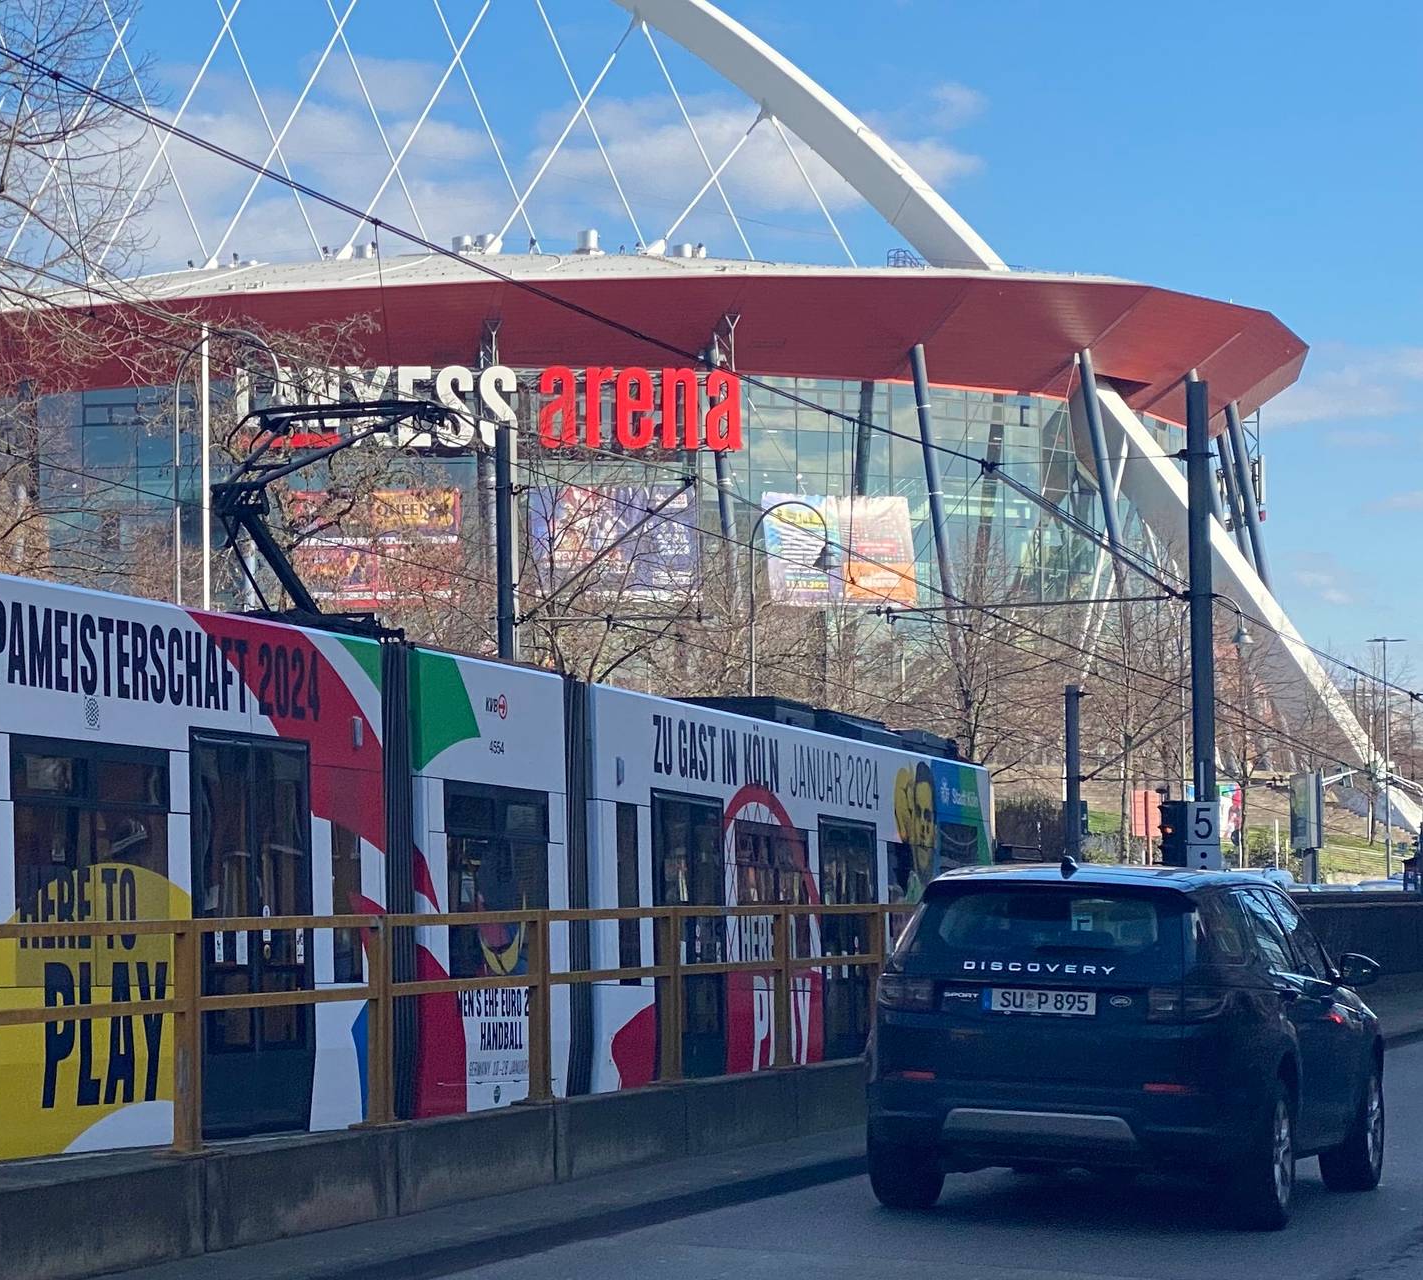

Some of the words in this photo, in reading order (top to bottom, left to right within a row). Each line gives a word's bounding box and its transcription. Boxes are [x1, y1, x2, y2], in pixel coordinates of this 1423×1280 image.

[539, 366, 742, 450] arena
[258, 641, 320, 721] 2024
[485, 696, 498, 713] KVB
[489, 740, 505, 755] 4554
[653, 715, 673, 775] ZU
[677, 719, 716, 782] GAST
[722, 729, 737, 786] IN
[744, 725, 779, 793] KÖLN
[790, 744, 842, 803] JANUAR
[847, 754, 879, 811] 2024
[1194, 807, 1213, 840] 5
[19, 866, 92, 949] HERE
[101, 868, 137, 950] TO
[963, 960, 1115, 975] DISCOVERY
[484, 988, 499, 1017] EHF
[501, 988, 522, 1017] EURO
[944, 991, 979, 1000] SPORT
[1000, 991, 1024, 1008] SU
[1037, 992, 1049, 1009] P
[1053, 993, 1089, 1012] 895
[42, 962, 168, 1109] PLAY
[480, 1022, 523, 1051] HANDBALL
